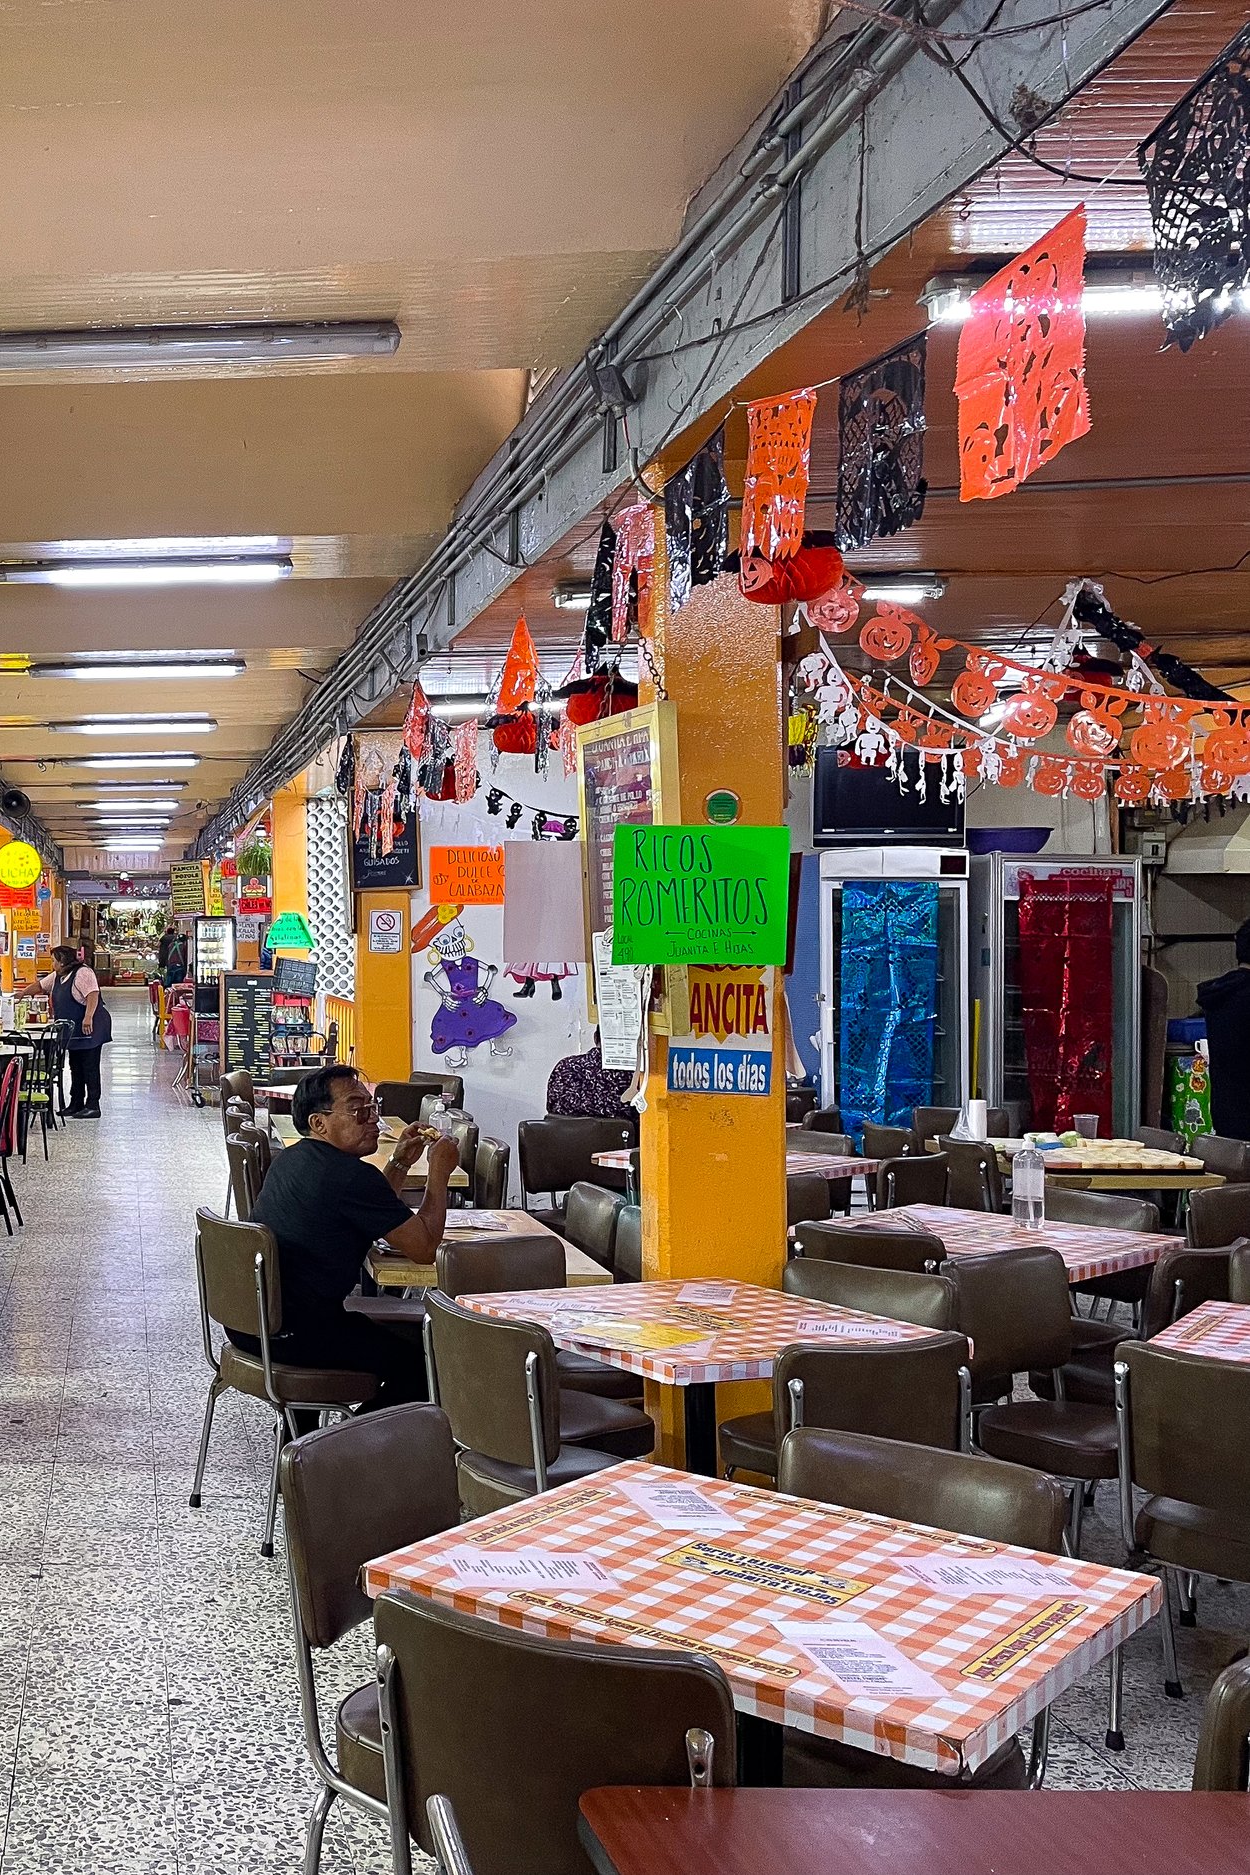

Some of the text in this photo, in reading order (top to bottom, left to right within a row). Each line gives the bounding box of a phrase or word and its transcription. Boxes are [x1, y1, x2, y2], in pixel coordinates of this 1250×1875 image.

[447, 849, 501, 865] DELICIOSO
[633, 829, 713, 874] RICOS
[457, 866, 493, 878] DULCE
[1062, 867, 1121, 876] cocinas
[619, 877, 768, 926] ROMERITOS
[687, 928, 733, 940] COCINAS
[667, 941, 754, 957] JUANITA E HIJAS
[689, 982, 769, 1035] ANCITA
[673, 1053, 766, 1092] todos los días
